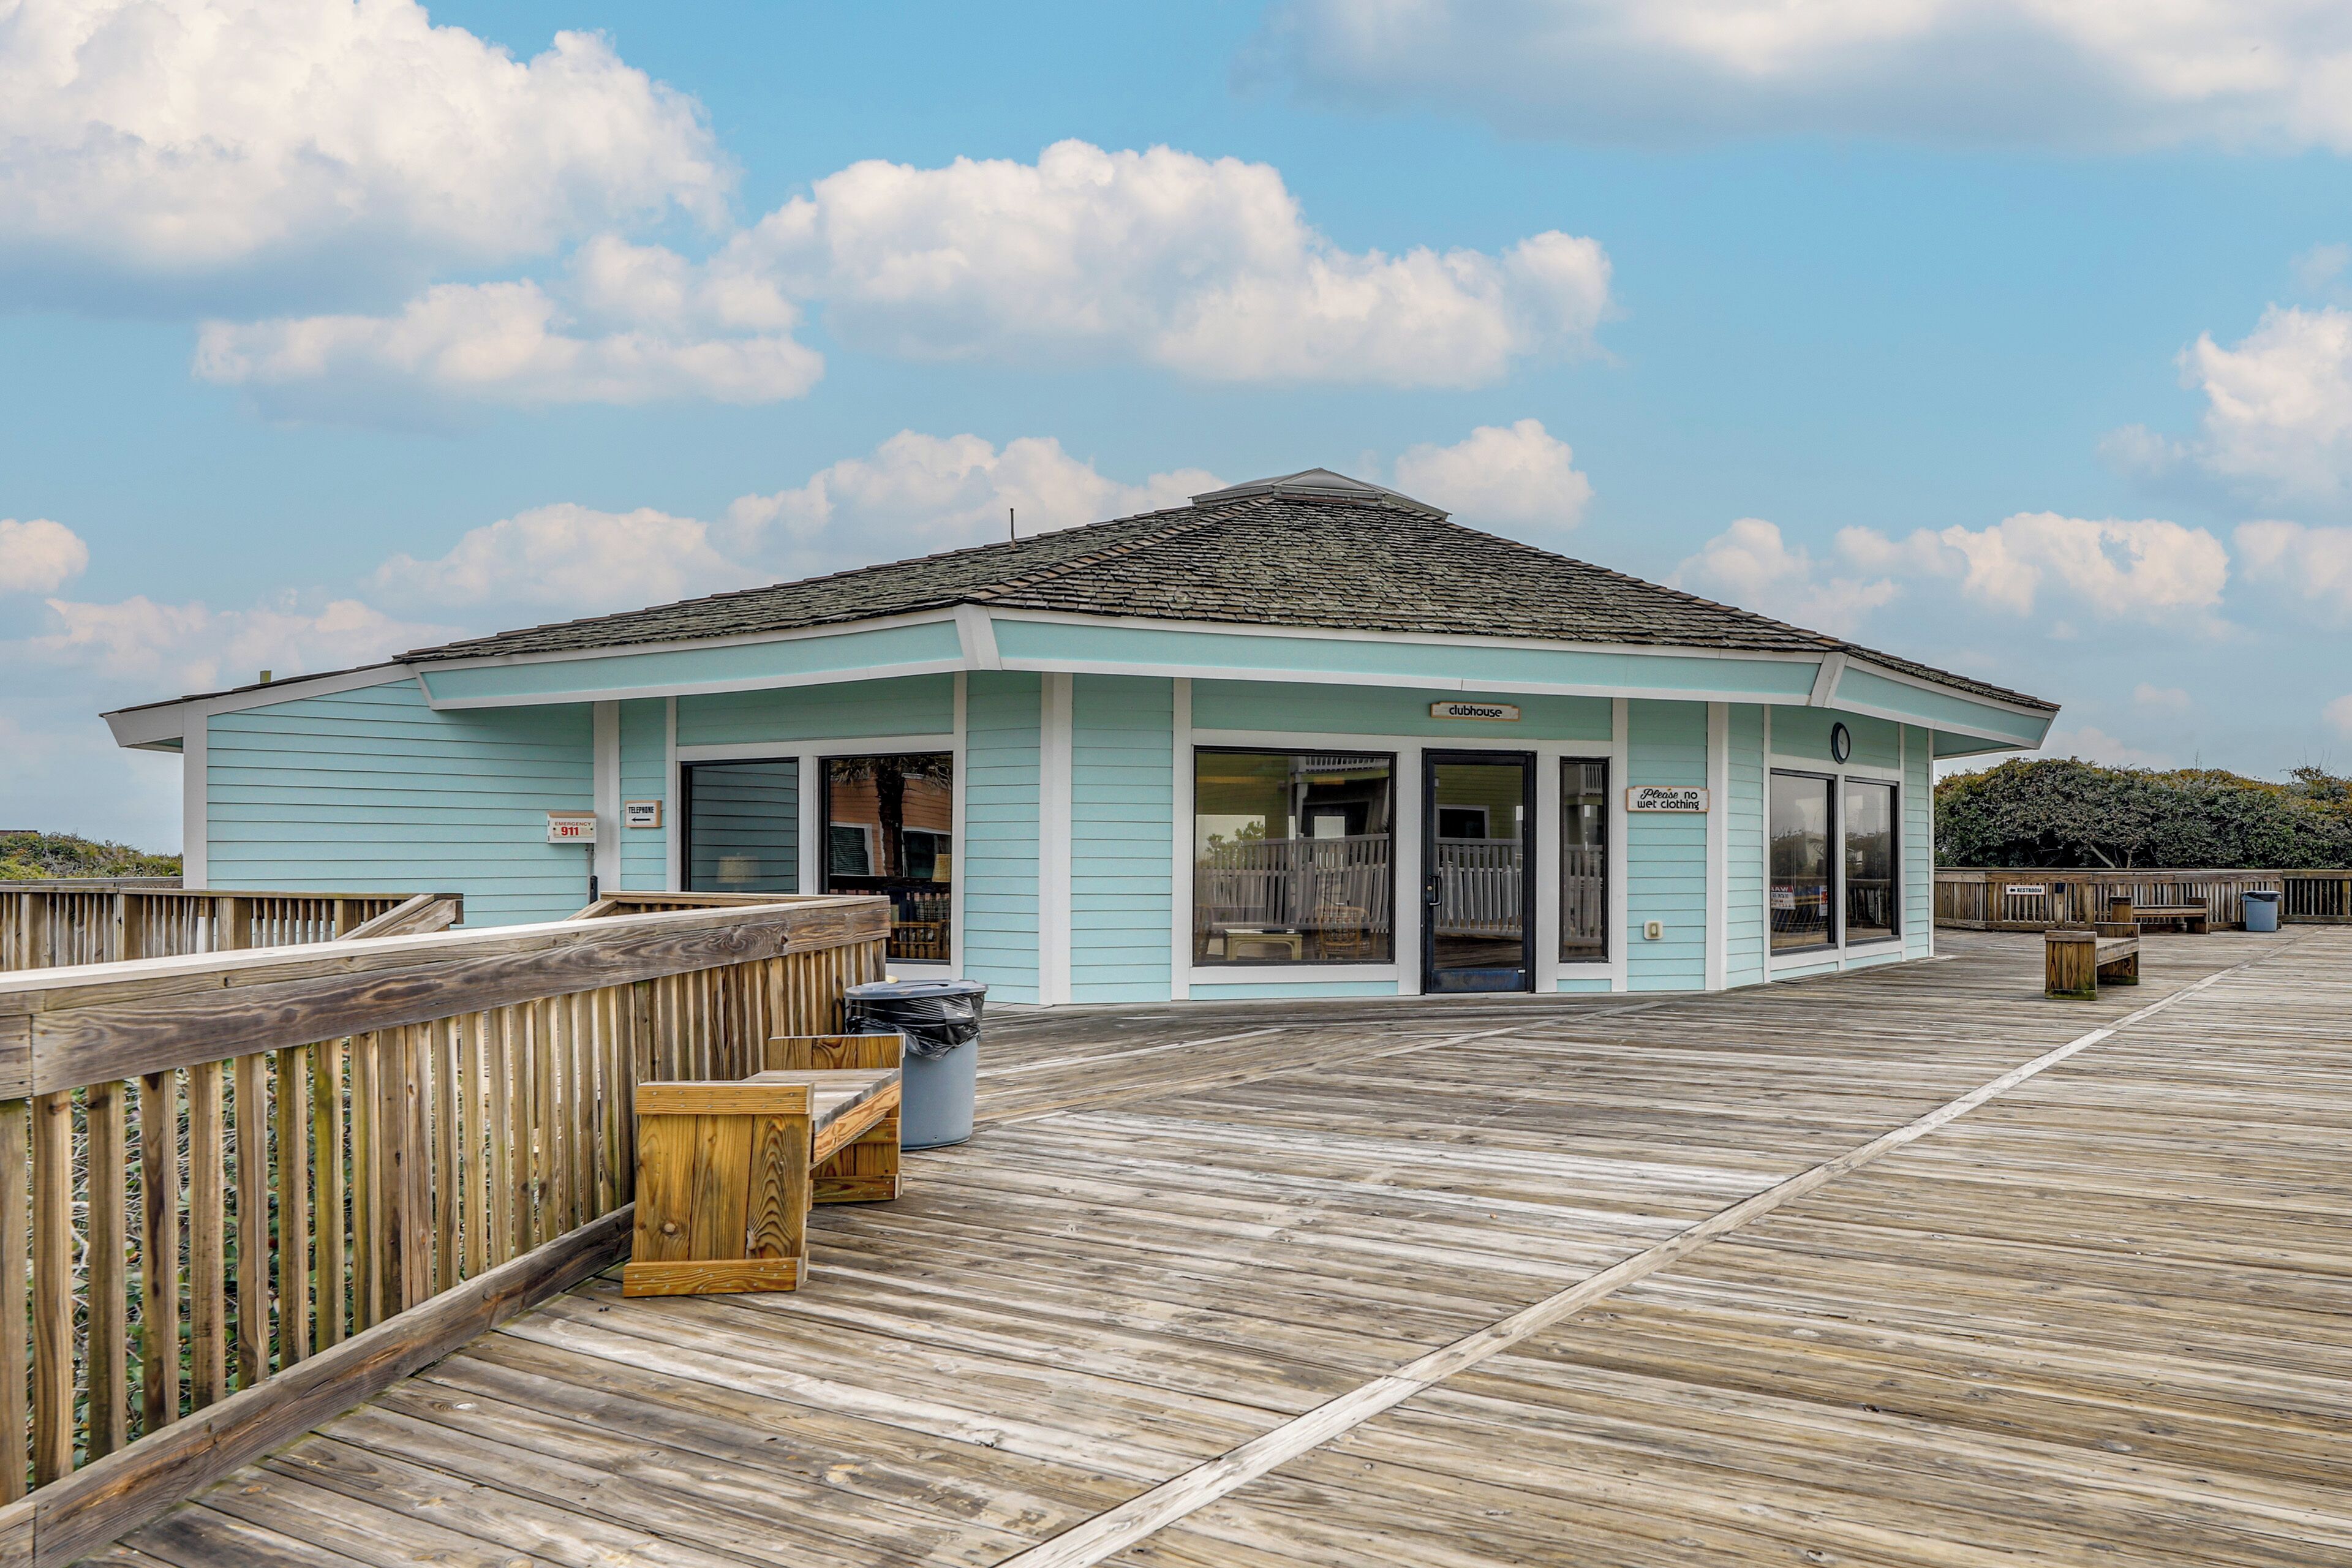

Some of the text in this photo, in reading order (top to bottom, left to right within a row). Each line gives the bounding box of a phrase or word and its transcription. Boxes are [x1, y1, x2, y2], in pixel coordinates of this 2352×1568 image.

[1449, 705, 1502, 717] clubhouse
[1640, 788, 1678, 799] Please
[1637, 799, 1700, 810] wet clothing
[561, 826, 579, 836] 911
